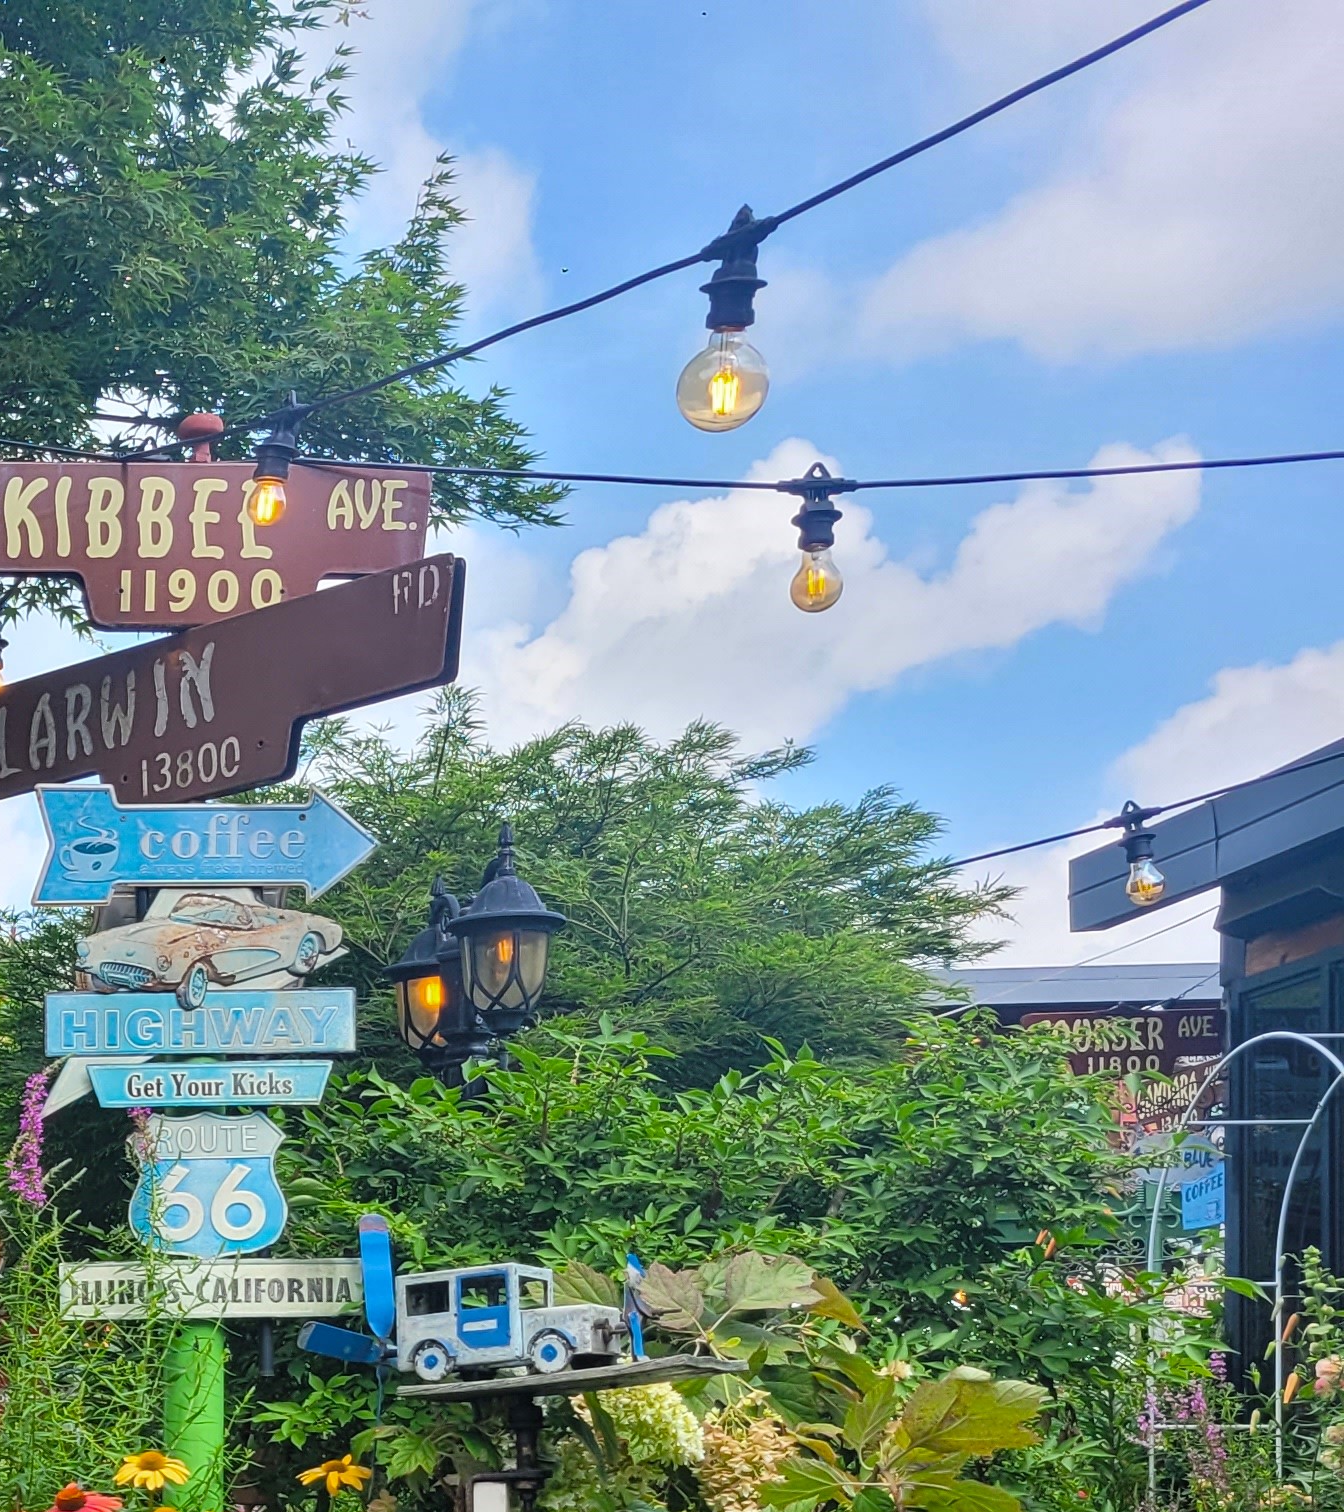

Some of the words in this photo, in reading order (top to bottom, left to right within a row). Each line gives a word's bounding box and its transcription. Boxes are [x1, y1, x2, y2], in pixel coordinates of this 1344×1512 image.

[326, 478, 418, 532] AVE.
[119, 569, 283, 613] 11900
[141, 735, 241, 797] 13800
[139, 813, 306, 860] coffee
[249, 860, 304, 875] brewed
[61, 1005, 339, 1050] HIGHWAY
[1177, 1015, 1218, 1038] AVE.
[1087, 1054, 1161, 1076] 11800
[127, 1073, 163, 1098] Get
[170, 1072, 224, 1097] Your
[232, 1071, 293, 1096] Kicks
[154, 1124, 258, 1153] ROUTE
[160, 1163, 267, 1243] 66
[1185, 1172, 1224, 1203] COFFEE
